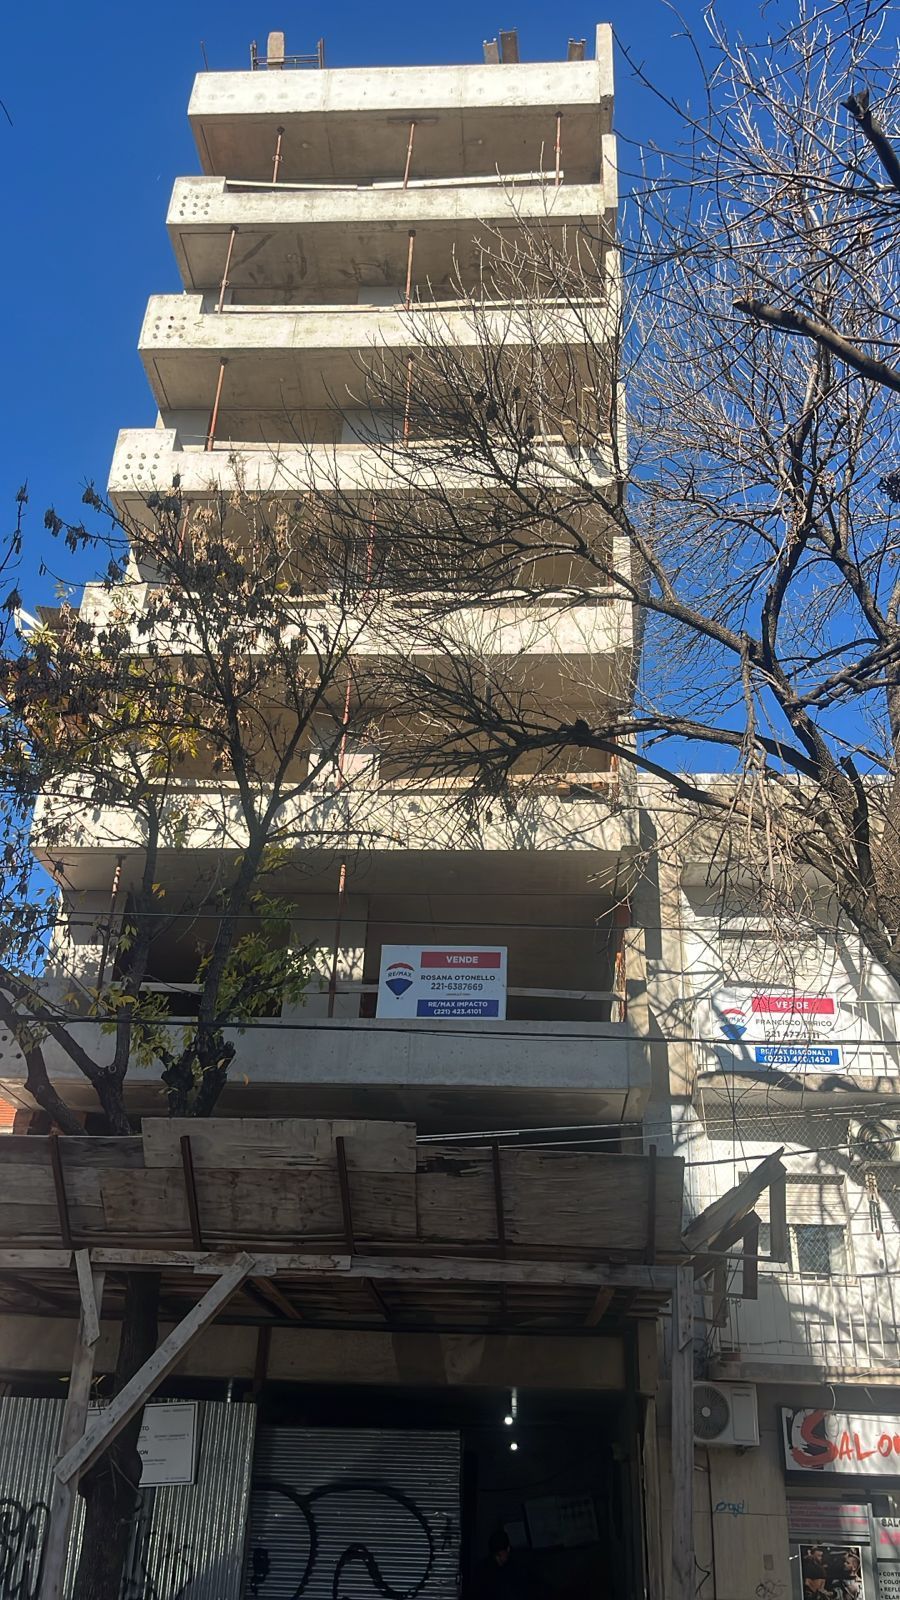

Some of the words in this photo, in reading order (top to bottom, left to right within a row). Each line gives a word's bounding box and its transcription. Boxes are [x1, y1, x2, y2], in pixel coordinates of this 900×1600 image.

[446, 956, 479, 964] VENDE
[387, 970, 412, 978] RE/MAX
[431, 982, 483, 991] 221-6387669
[755, 1018, 801, 1026] FRANCISCO
[881, 1518, 900, 1527] SAL
